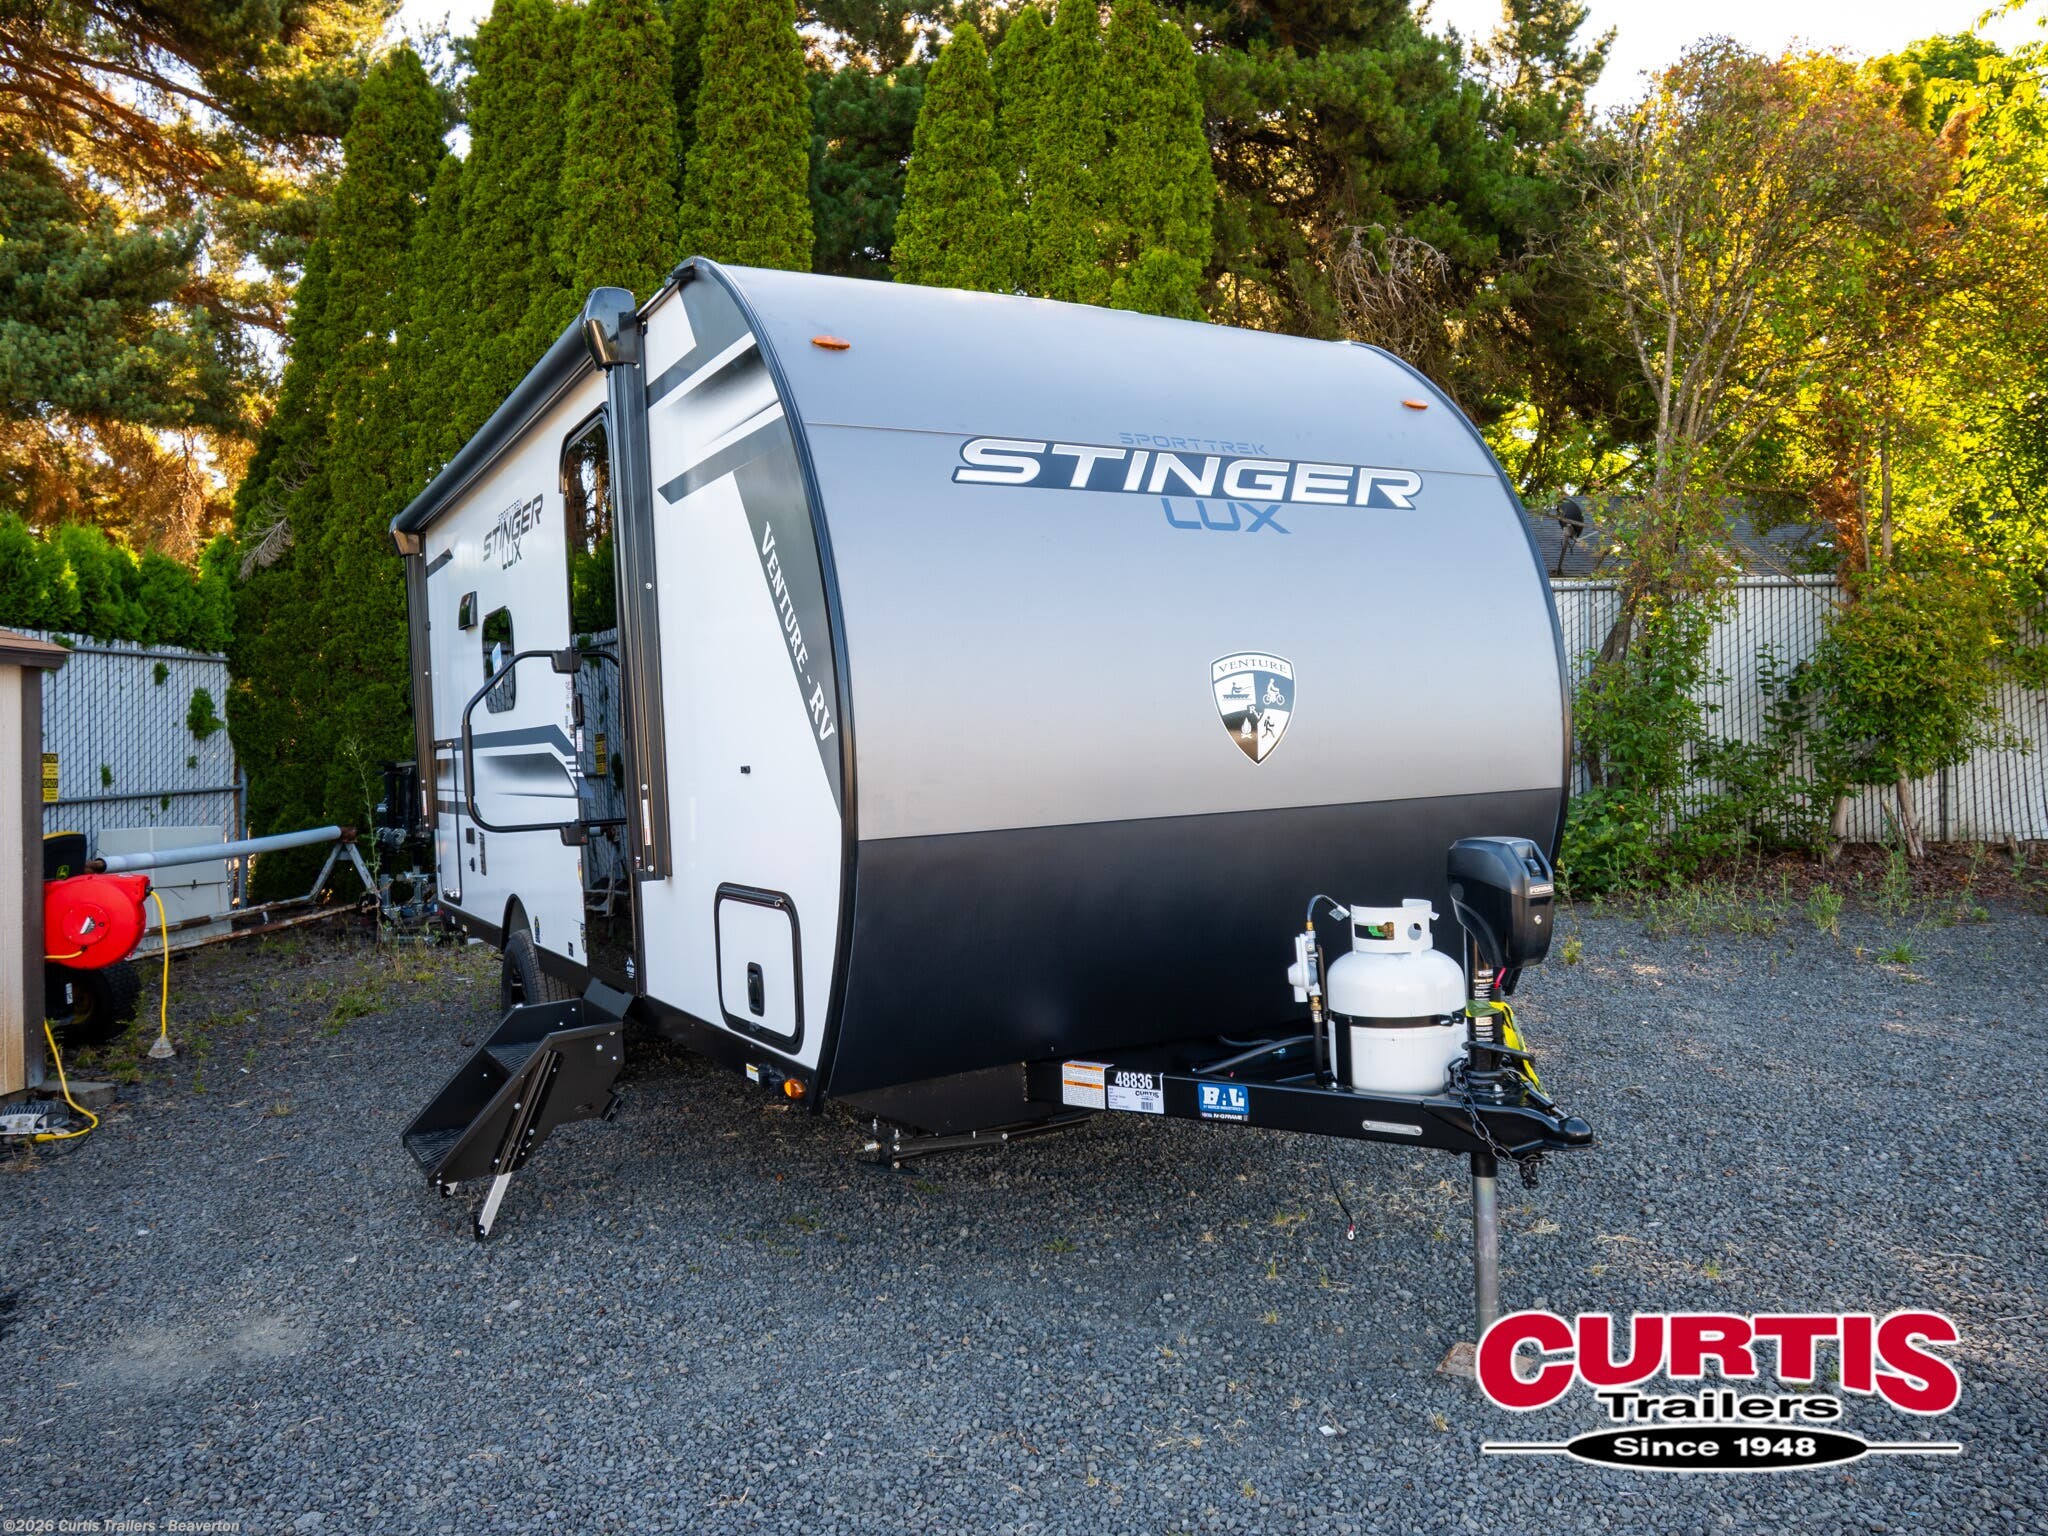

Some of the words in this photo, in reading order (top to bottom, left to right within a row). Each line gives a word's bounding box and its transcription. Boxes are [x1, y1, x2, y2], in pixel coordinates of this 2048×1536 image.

[1119, 432, 1269, 456] SPORTTREK
[953, 436, 1423, 509] STINGER
[482, 493, 544, 562] STINGER
[1159, 497, 1292, 534] LUX
[501, 537, 522, 571] LUX
[762, 520, 809, 673] VENTURE
[809, 682, 835, 741] RV
[1219, 659, 1287, 674] VENTURE
[1115, 1071, 1153, 1090] 48836
[1135, 1090, 1159, 1099] CURTIS
